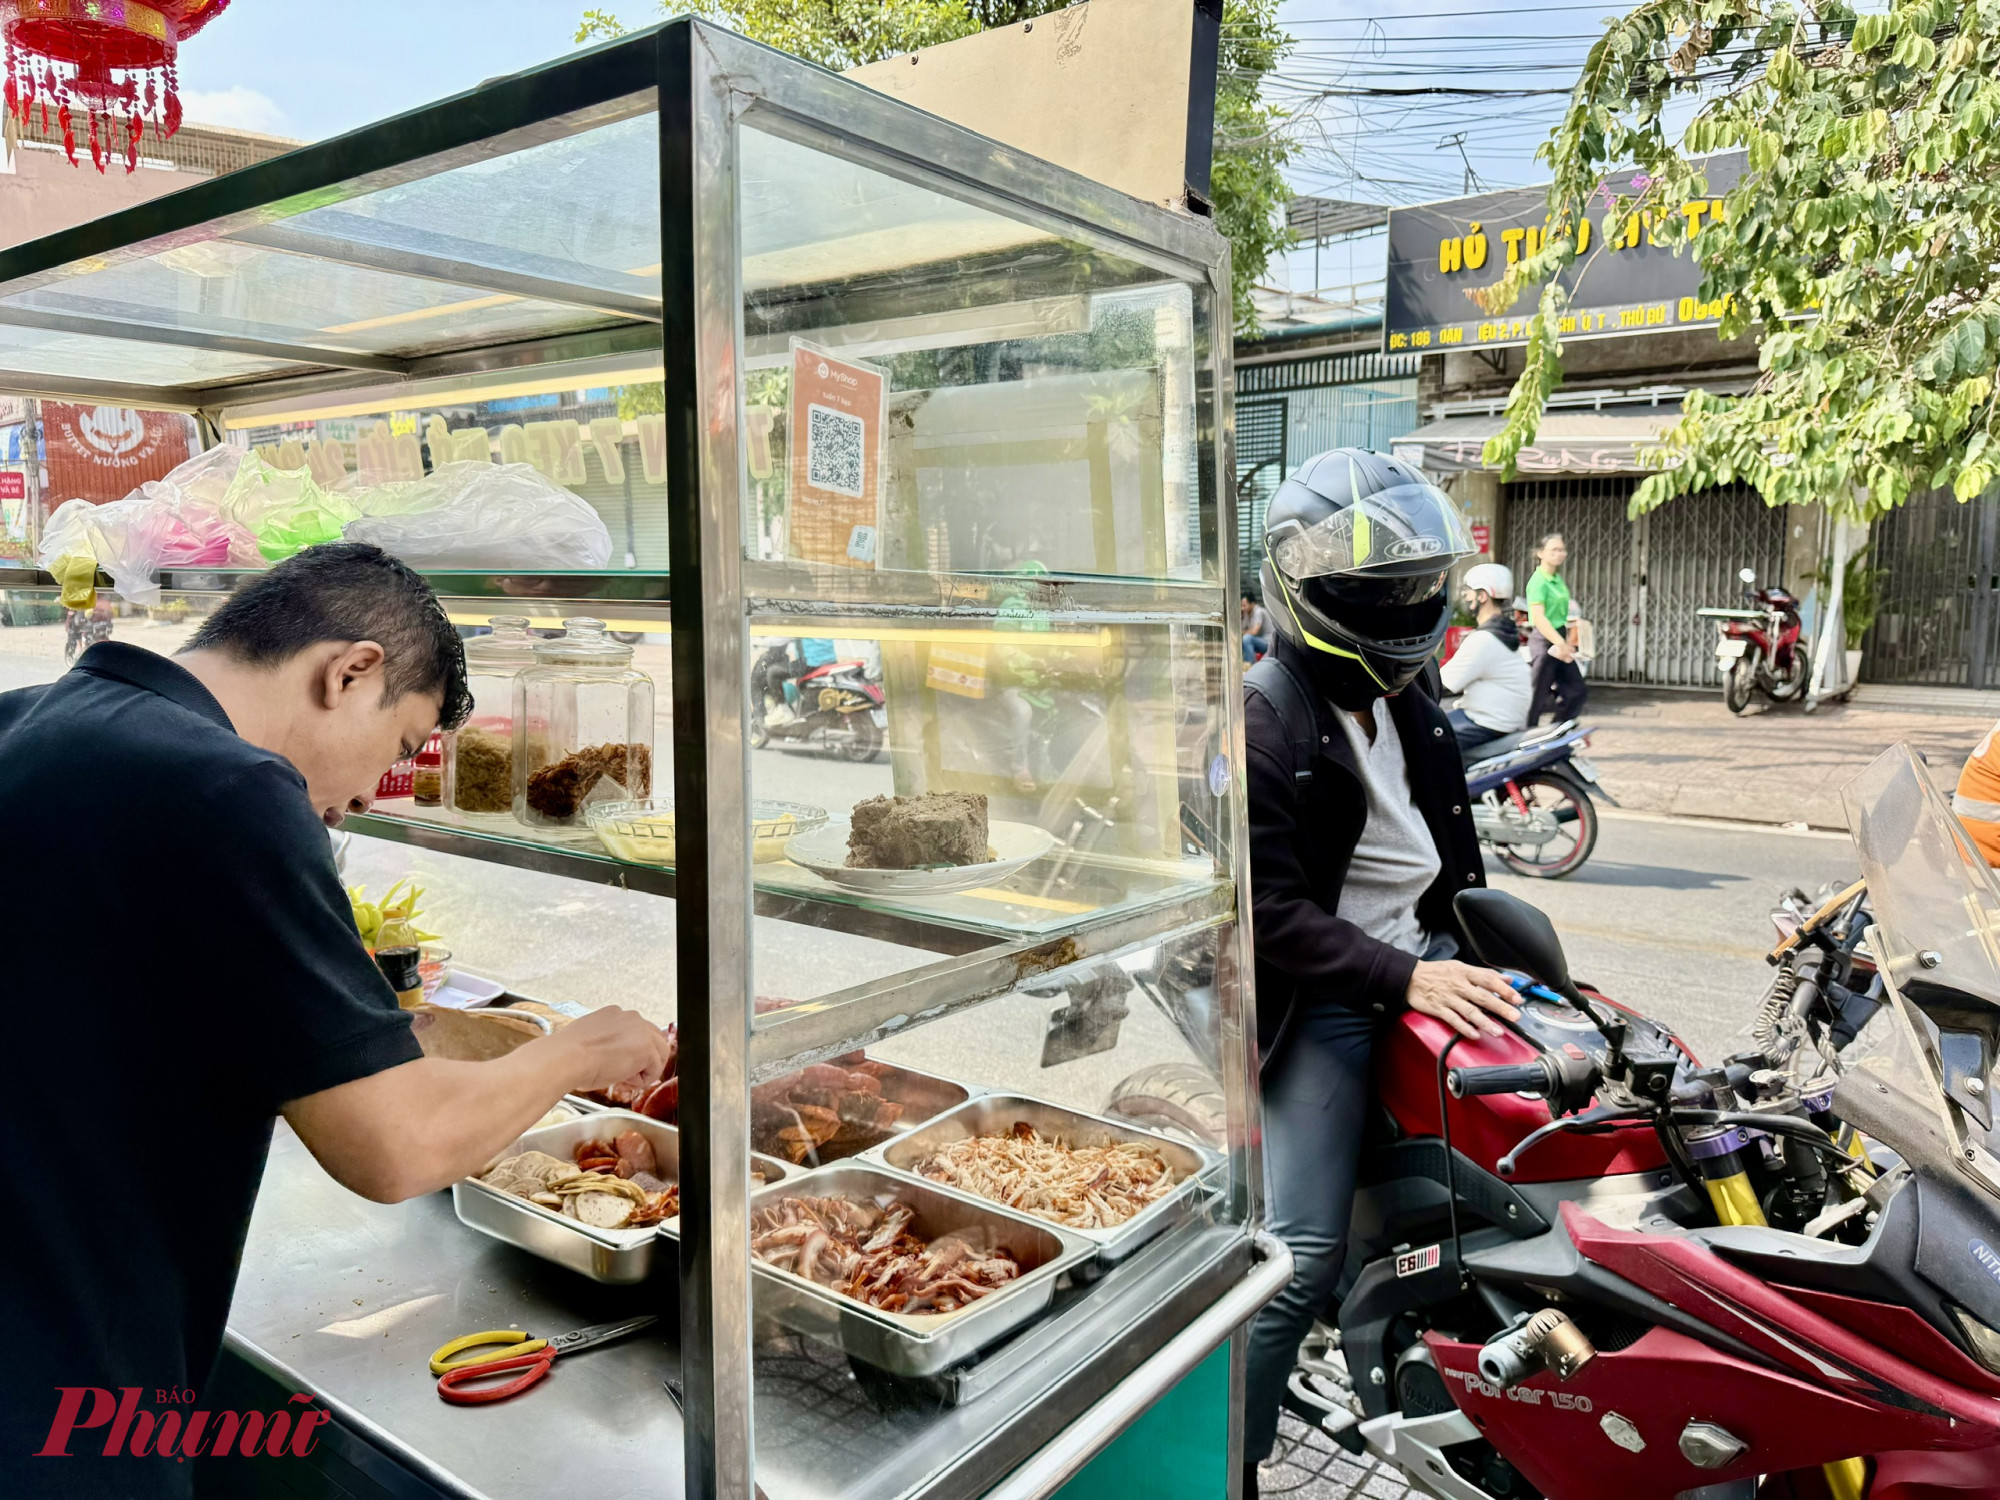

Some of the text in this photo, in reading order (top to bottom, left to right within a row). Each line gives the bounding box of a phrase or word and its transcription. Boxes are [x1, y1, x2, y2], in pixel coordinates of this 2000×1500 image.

[1440, 220, 1487, 274] HỦ
[830, 369, 858, 387] MyShop
[1546, 1390, 1593, 1413] 150
